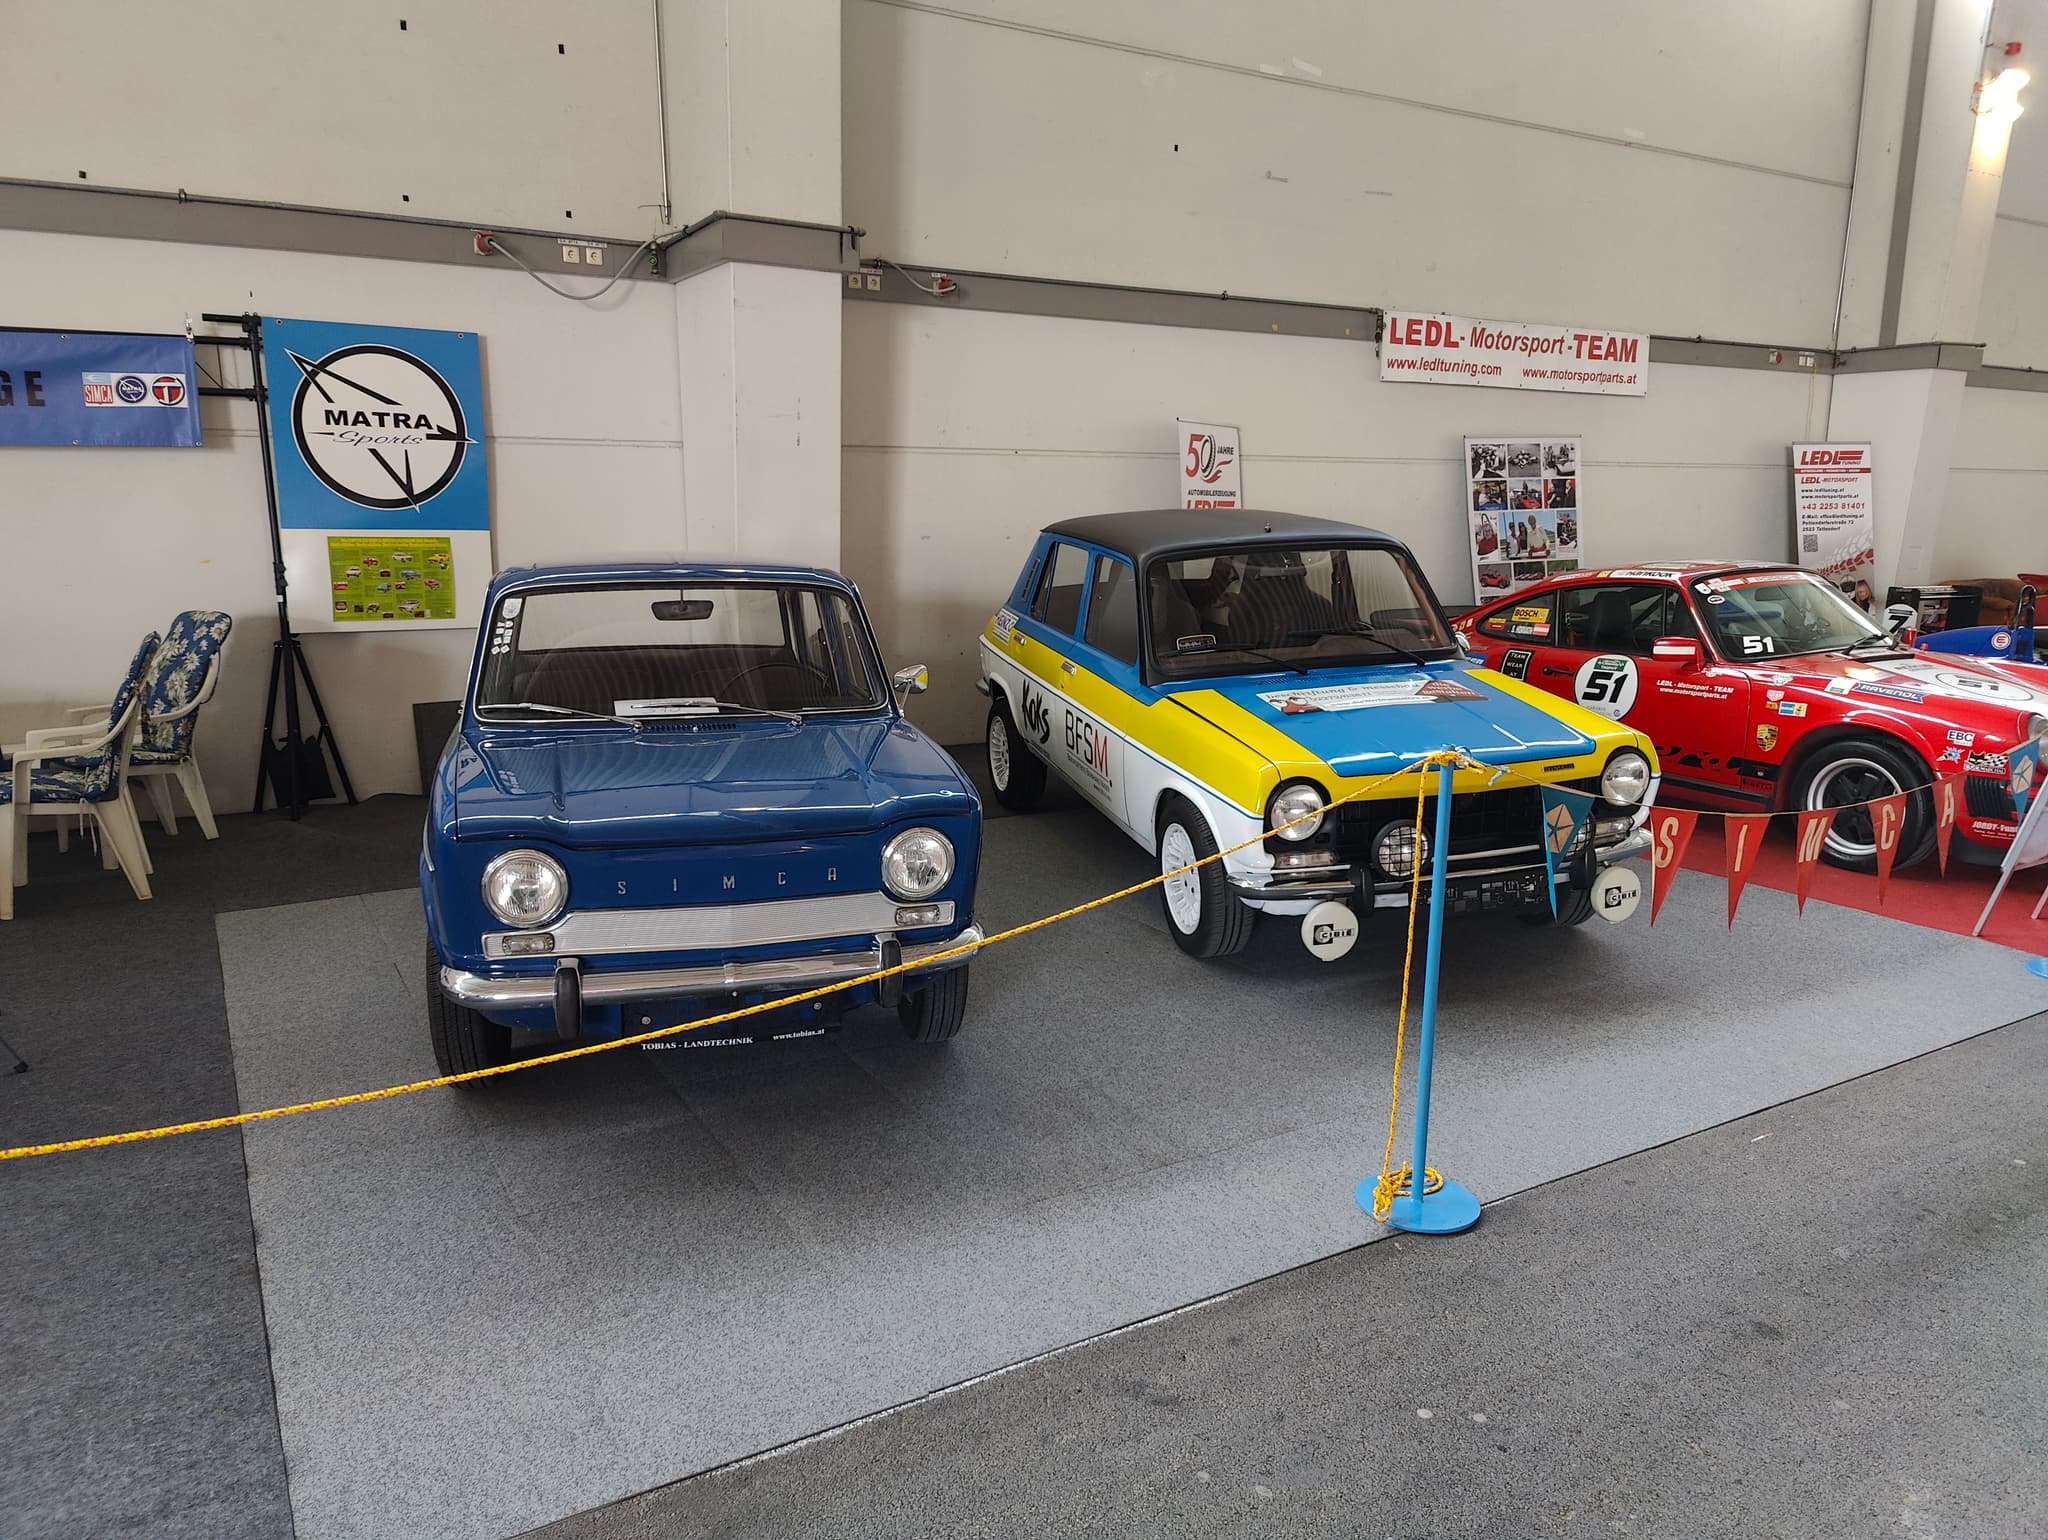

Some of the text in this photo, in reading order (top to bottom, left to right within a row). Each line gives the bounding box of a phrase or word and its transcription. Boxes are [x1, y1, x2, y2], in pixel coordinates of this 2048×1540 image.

[1470, 326, 1565, 358] Motorsport
[1387, 357, 1637, 385] www.ledltuning.com www.motorsportparts.at
[84, 384, 113, 404] SIMCA
[324, 409, 433, 430] MATRA
[333, 430, 423, 446] Sports
[1185, 433, 1216, 478] 50
[1800, 450, 1841, 465] LEDL
[1801, 476, 1821, 484] LEDL
[1514, 608, 1539, 617] BOSCH
[1743, 636, 1775, 654] 51
[1582, 671, 1629, 704] 51
[1713, 685, 1734, 694] TEAM
[1861, 684, 1919, 700] RAVENOL
[1948, 731, 1973, 742] EBC
[772, 1028, 825, 1041] www.tobias.at
[641, 1041, 677, 1051] TOBIAS
[684, 1036, 753, 1048] LANDTECHNIK
